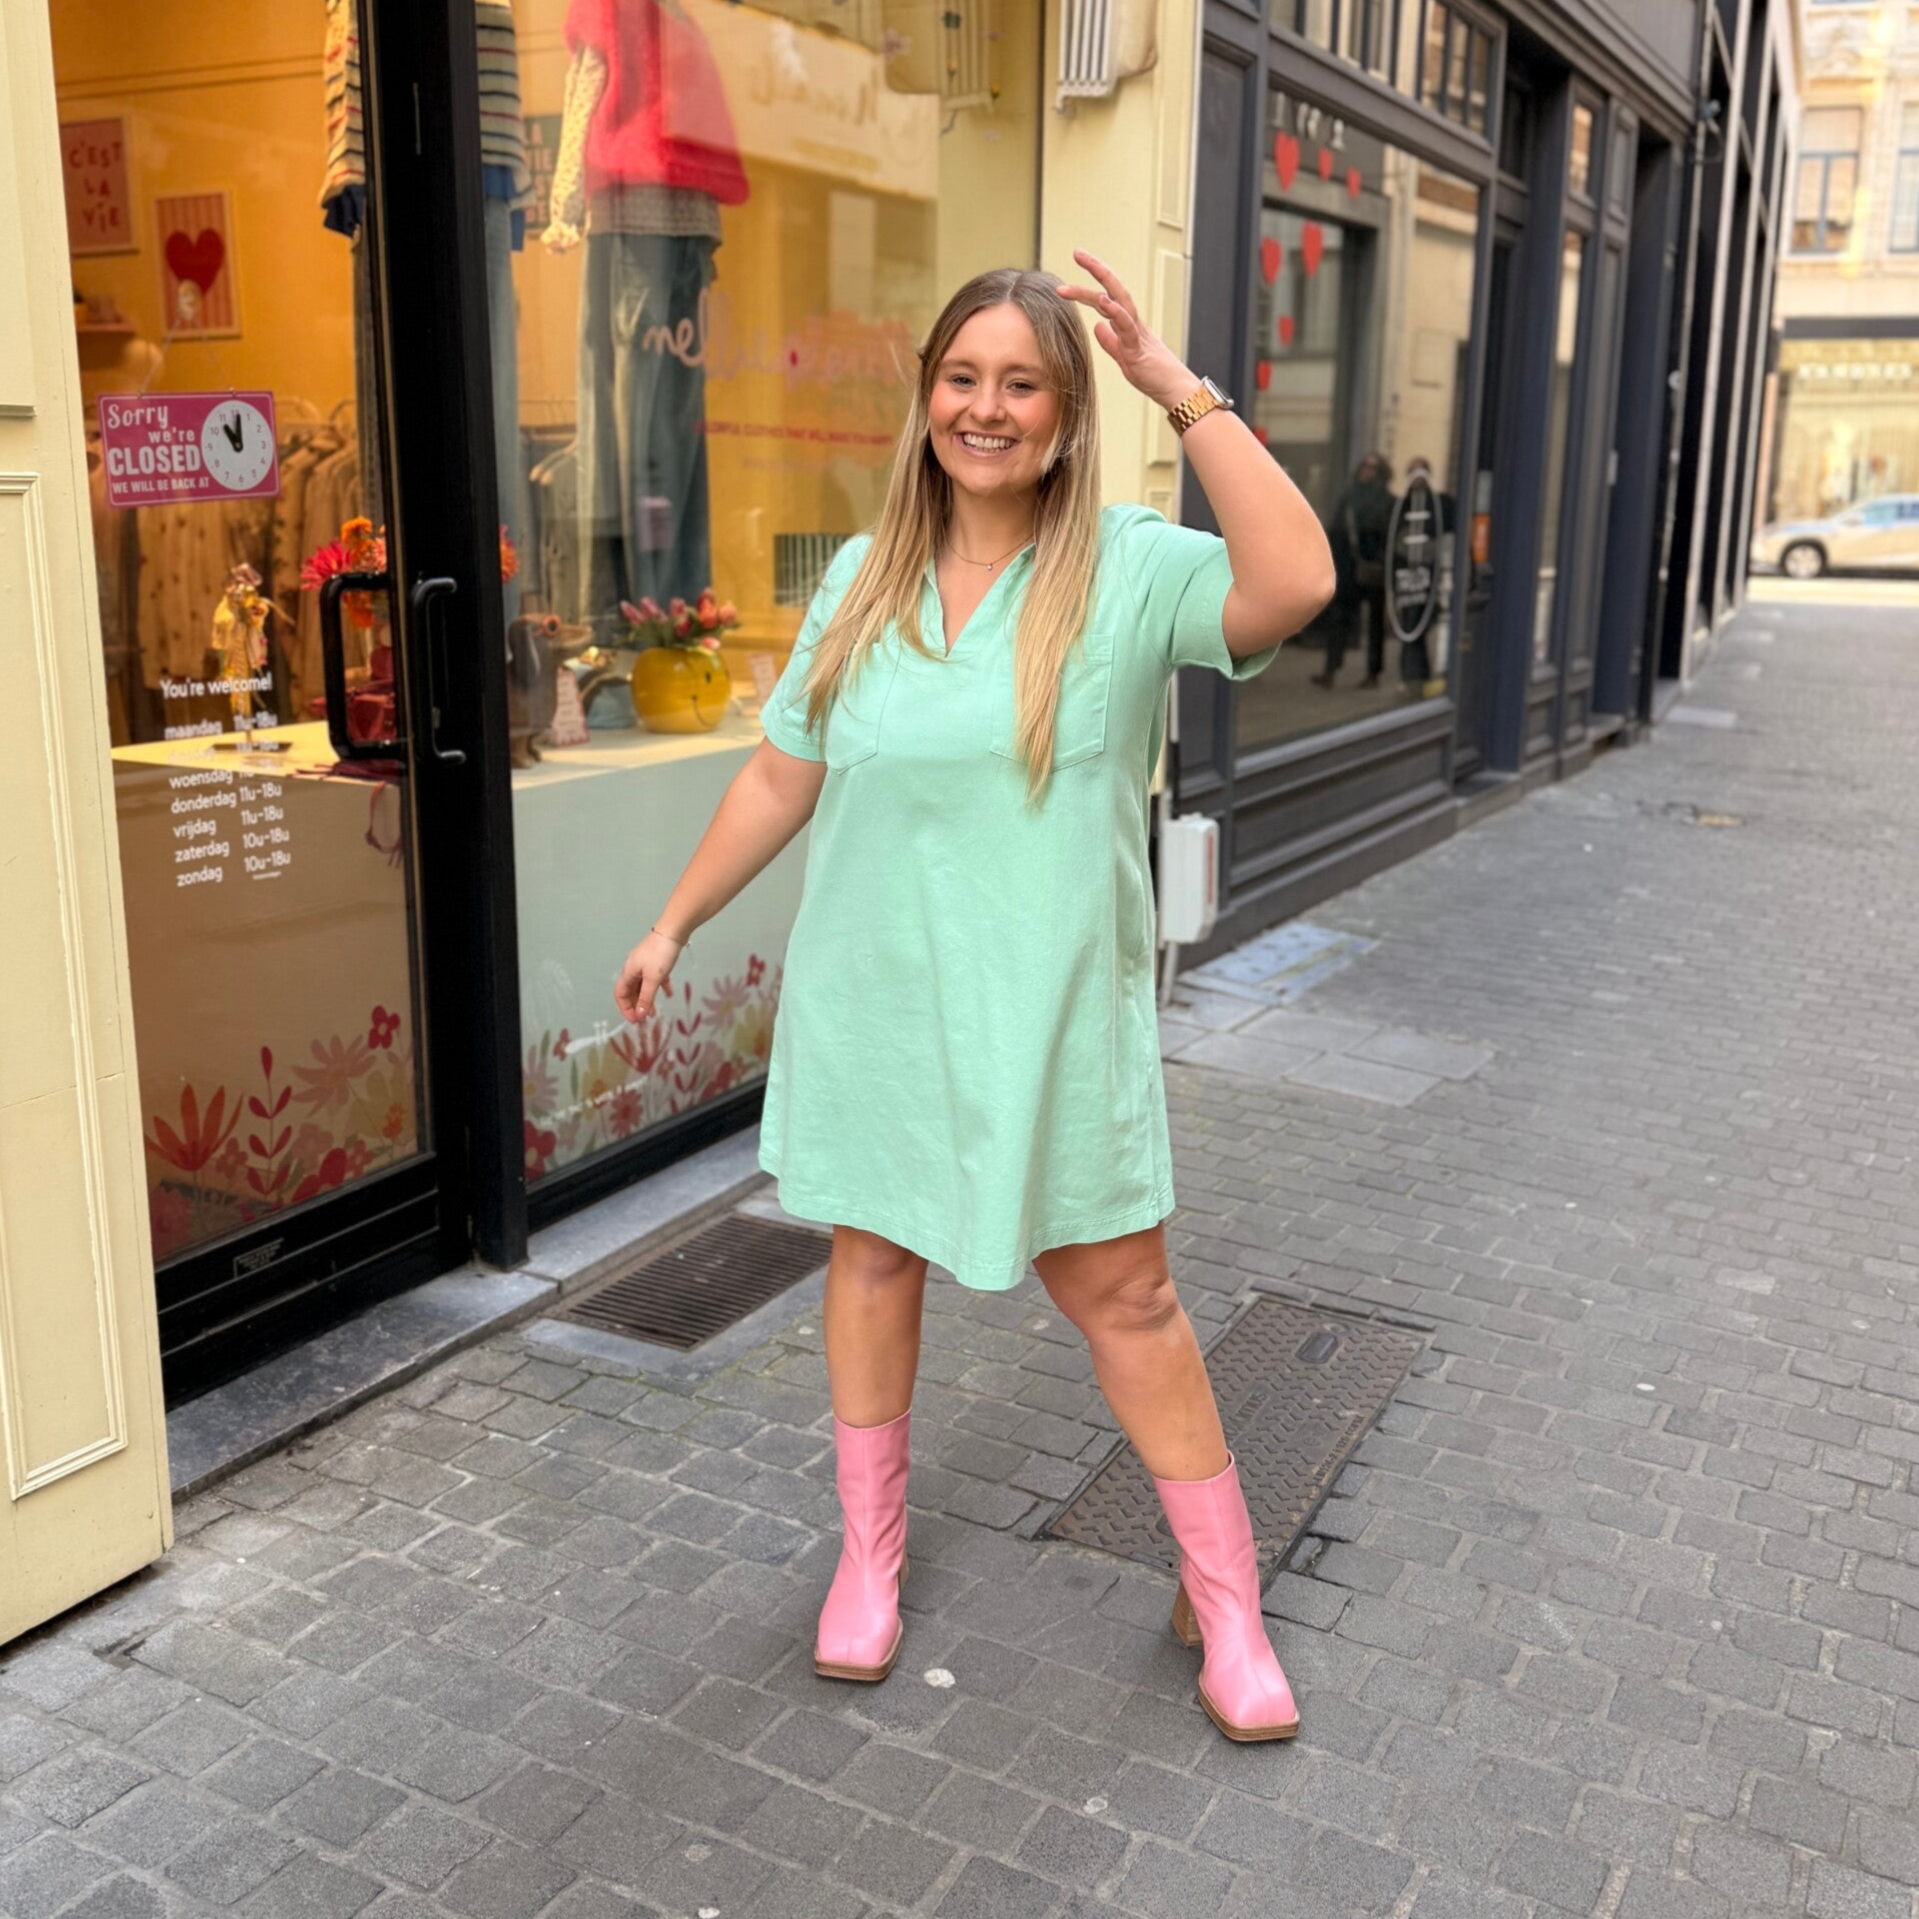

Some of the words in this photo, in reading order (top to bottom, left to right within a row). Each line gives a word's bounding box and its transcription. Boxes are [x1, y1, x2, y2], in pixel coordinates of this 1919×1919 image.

[68, 141, 121, 168] C'EST
[83, 177, 111, 197] LA
[107, 404, 168, 429] Sorry
[148, 427, 195, 443] we're
[210, 427, 219, 436] 10
[261, 440, 266, 449] 3
[108, 444, 201, 476] CLOSED
[207, 443, 213, 452] 9
[112, 482, 128, 494] WE
[131, 480, 155, 493] WILL
[157, 479, 168, 491] BE
[171, 478, 196, 490] BACK
[199, 477, 209, 488] AT
[160, 677, 205, 699] You're
[207, 671, 272, 694] welcome!
[164, 718, 222, 740] maandag
[233, 710, 278, 731] 11u-18u
[169, 769, 233, 789] woensdag
[171, 791, 237, 814] donderdag
[239, 782, 282, 802] 11u-18u
[173, 818, 217, 840] vrijdag
[241, 805, 284, 826] 11u-18u
[175, 840, 230, 863] zaterdag
[243, 827, 290, 849] 10u-18u
[177, 865, 223, 887] zondag
[244, 850, 291, 872] 10u-18u
